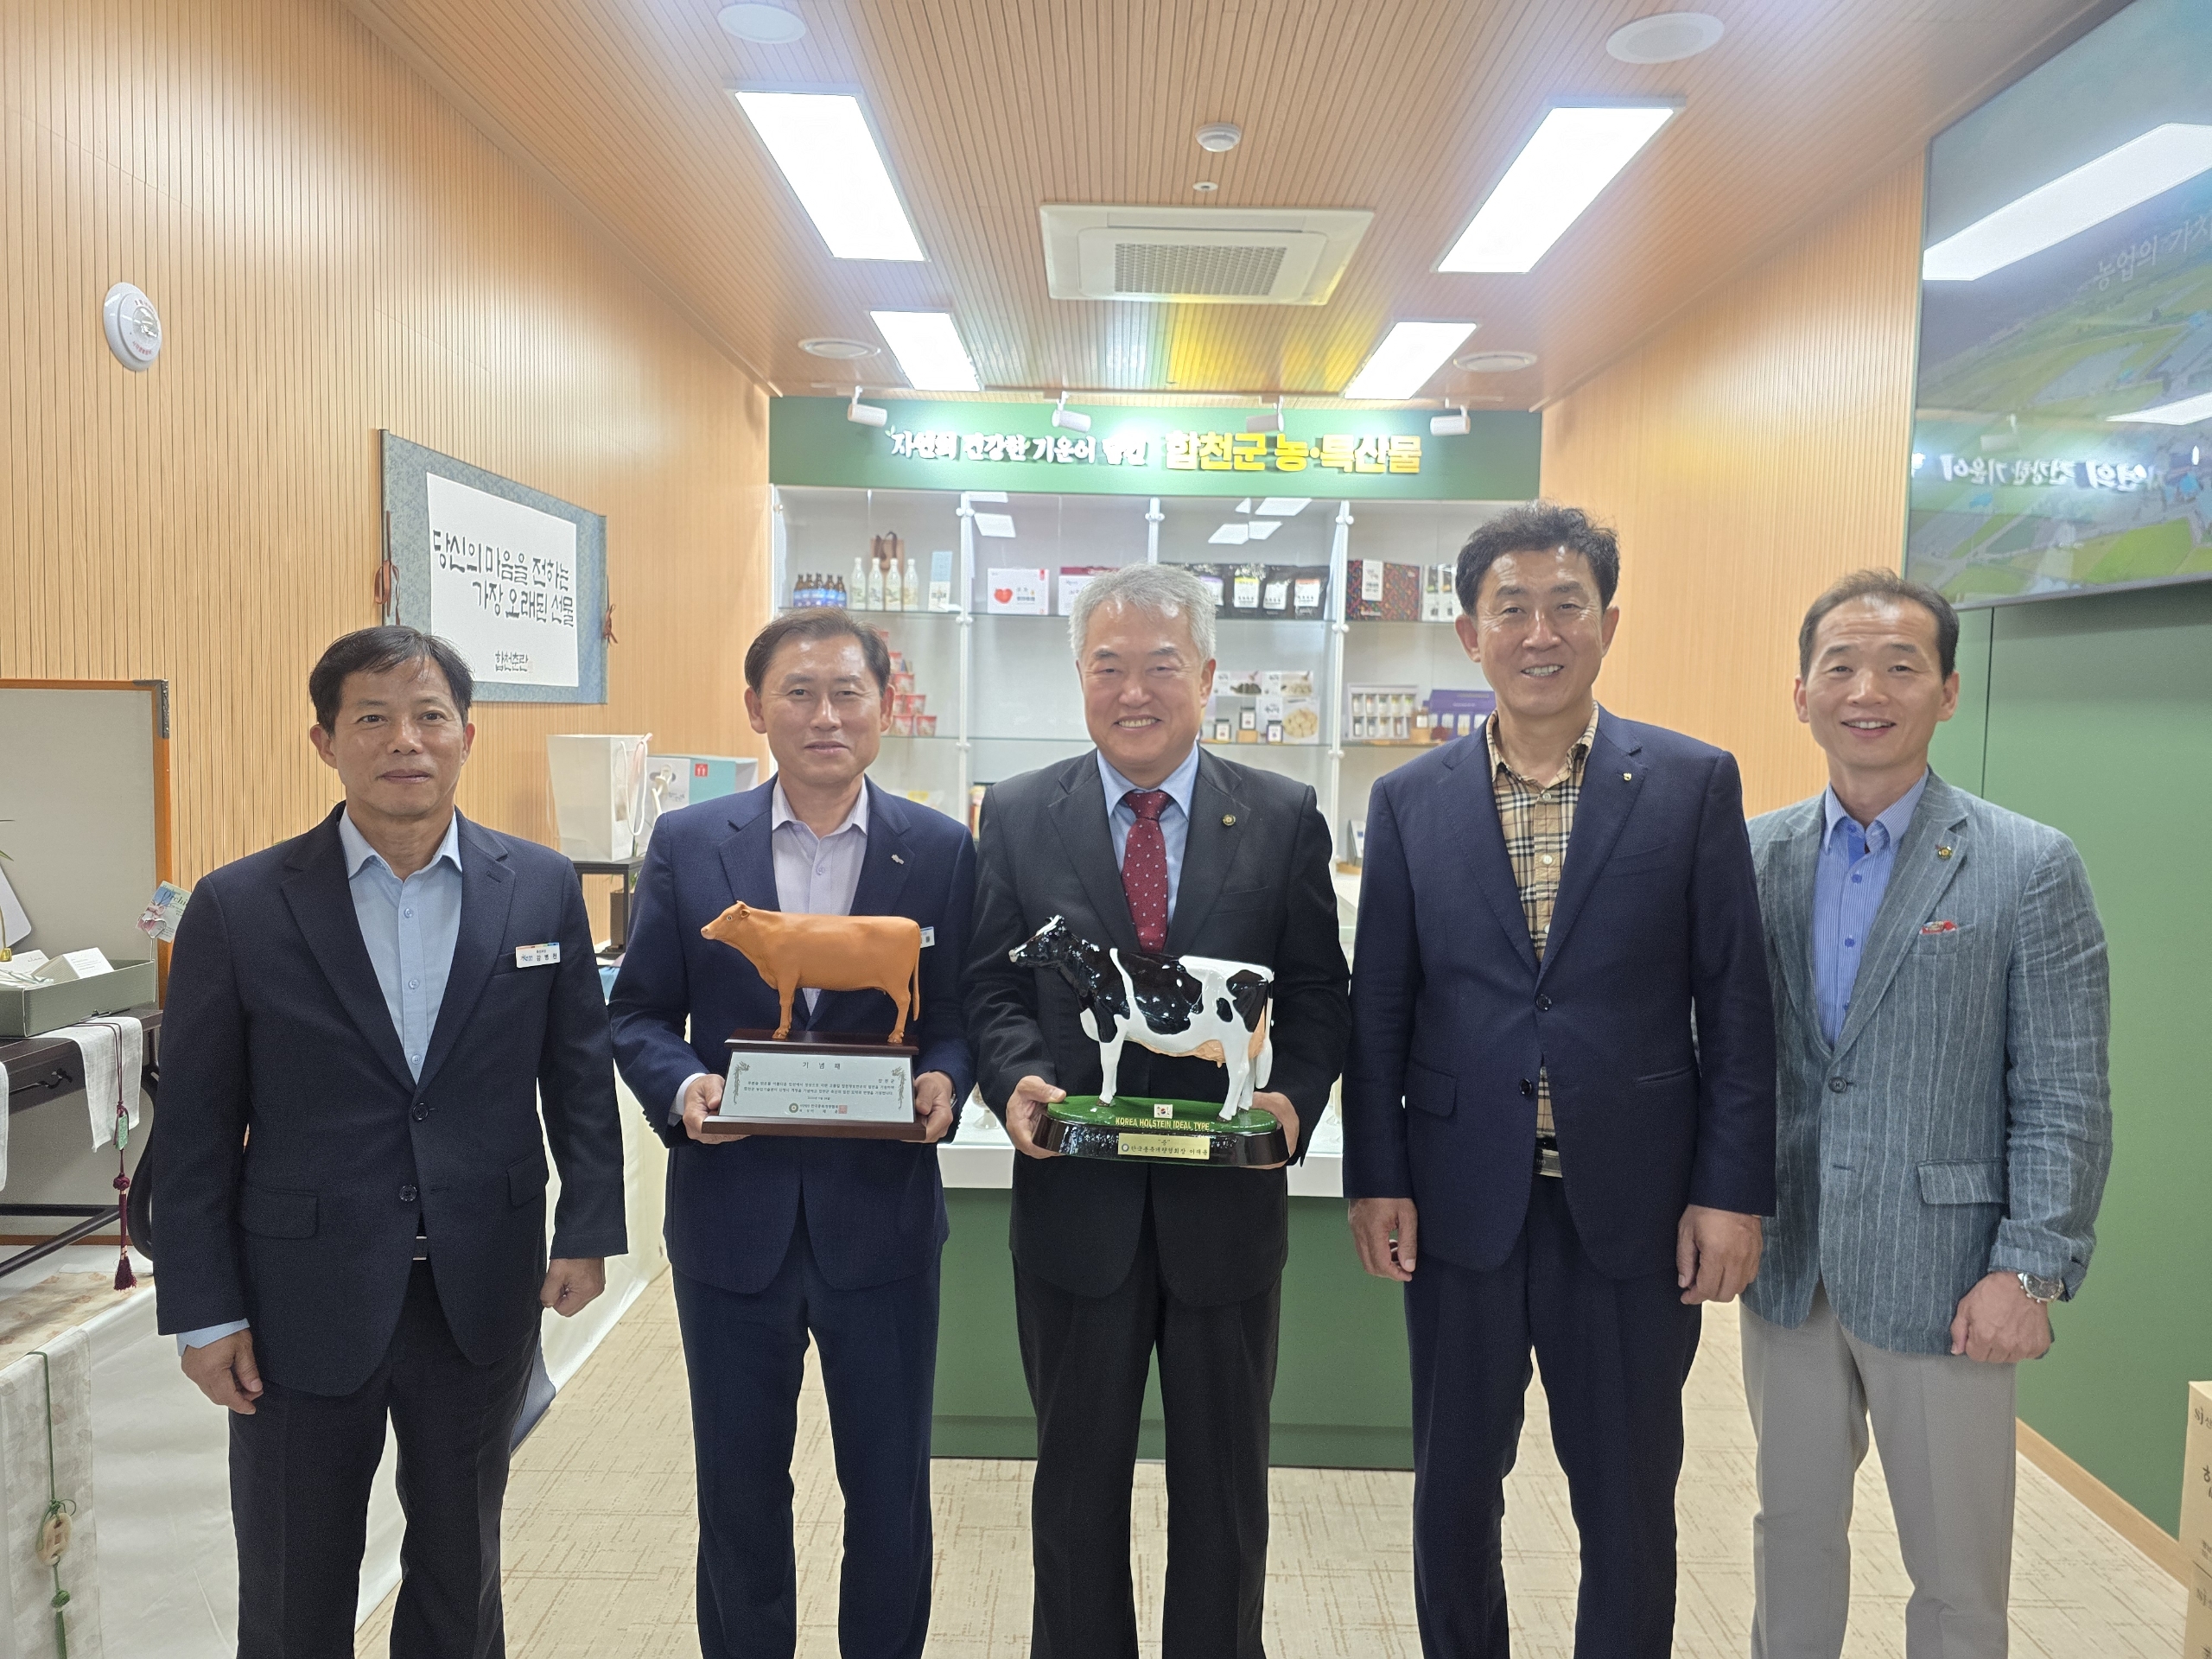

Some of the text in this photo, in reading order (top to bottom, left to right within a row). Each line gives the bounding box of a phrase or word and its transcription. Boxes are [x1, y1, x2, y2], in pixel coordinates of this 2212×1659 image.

[1033, 435, 1096, 463] 기운이
[1166, 430, 1267, 470] 합천군
[433, 529, 569, 591] 당신의 마음을 전하는
[472, 579, 574, 627] 가장 오래된 선물
[1116, 1116, 1210, 1131] KOREA HOLSTEIN IDEAL TYPE
